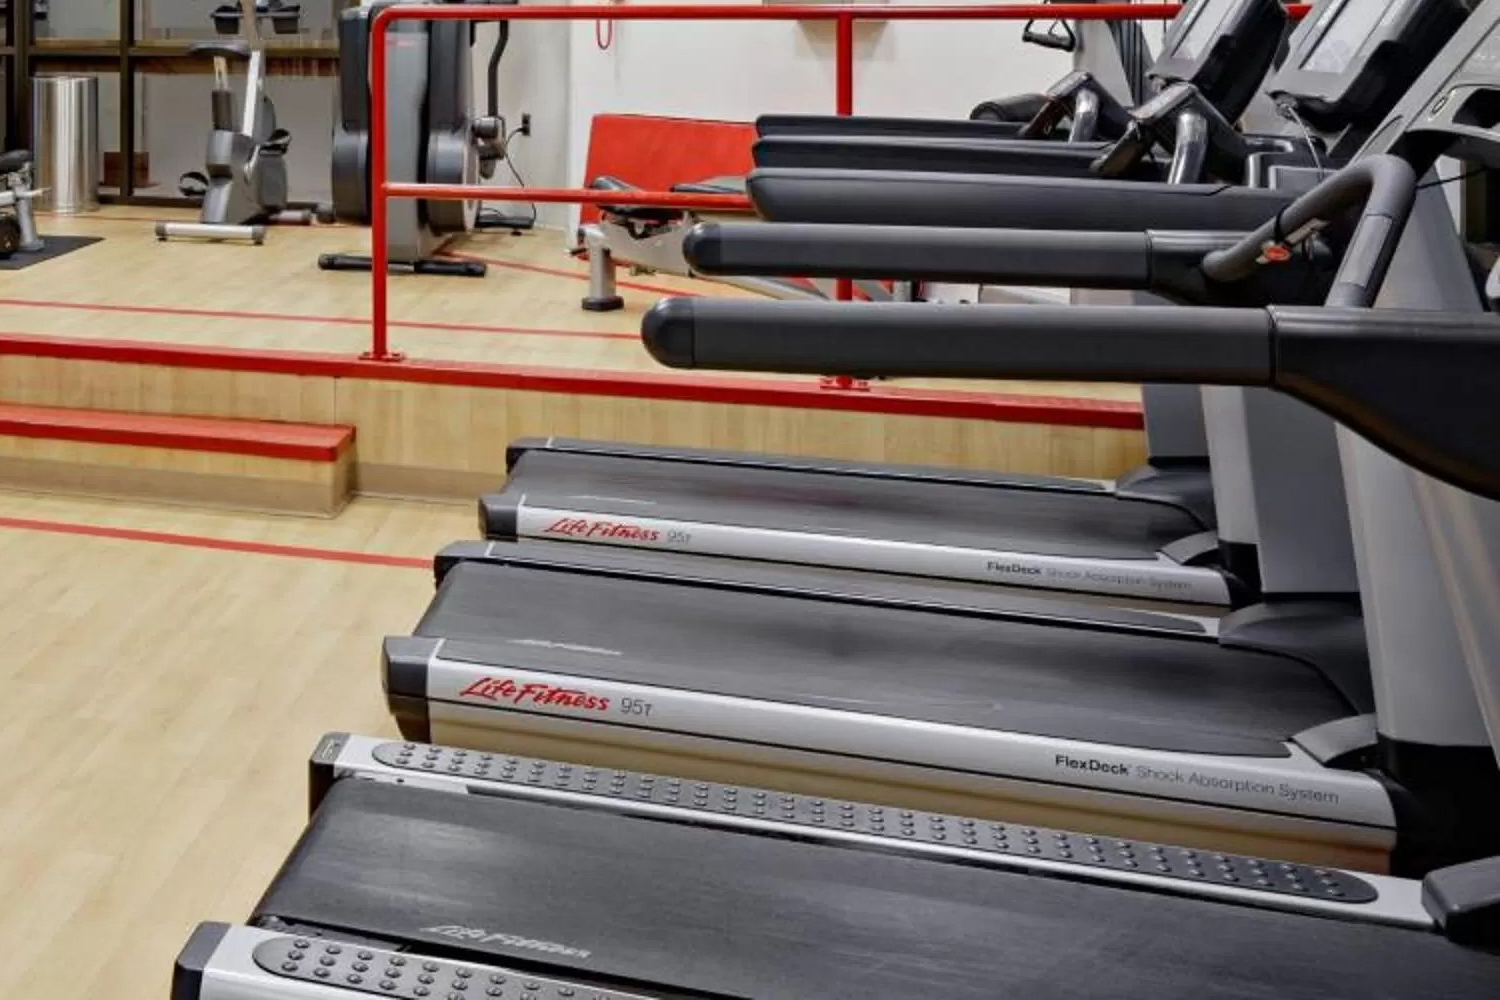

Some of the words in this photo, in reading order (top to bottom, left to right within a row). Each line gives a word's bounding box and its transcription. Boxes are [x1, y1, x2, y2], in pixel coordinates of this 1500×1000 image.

[620, 697, 653, 717] 95T
[1055, 754, 1130, 776] FlexDeck
[1136, 765, 1184, 783] Shock
[1188, 773, 1275, 797] Absorption
[1279, 783, 1340, 805] System
